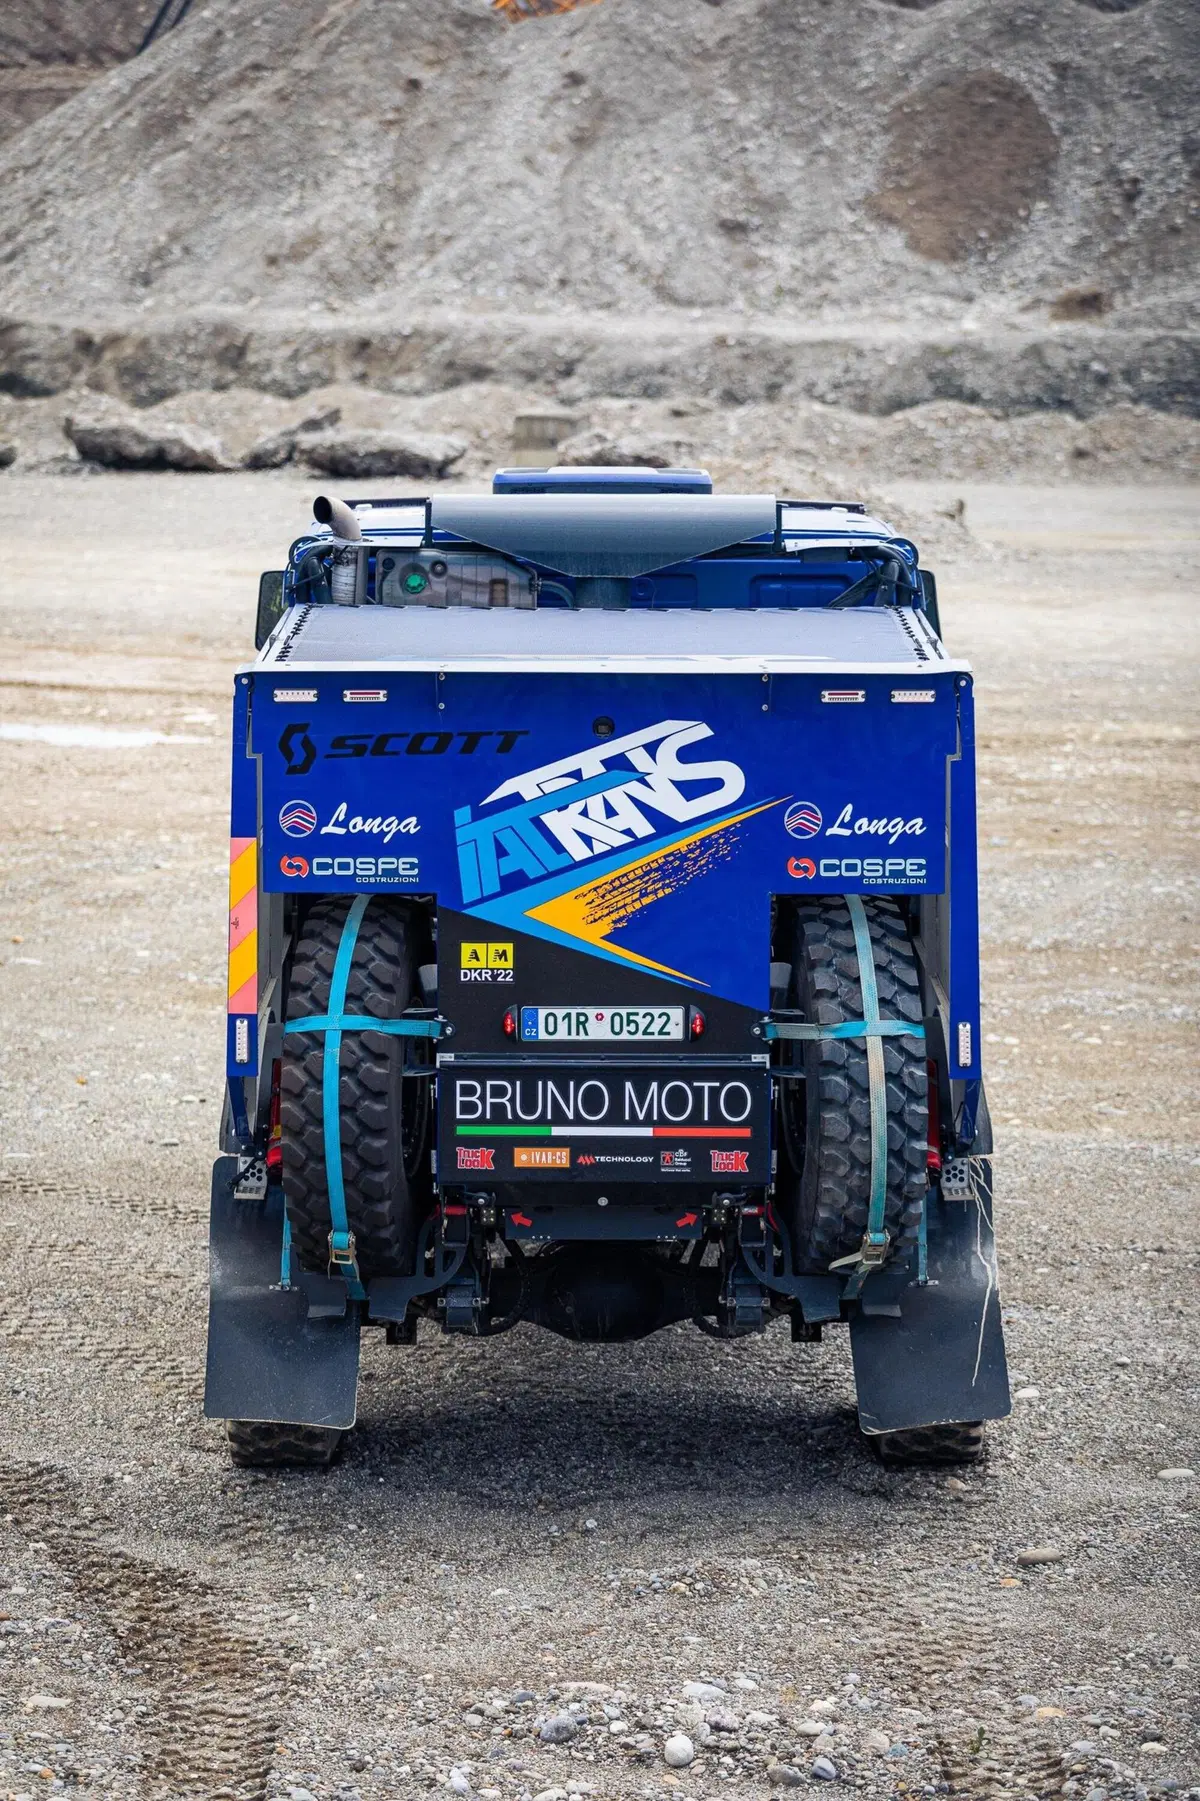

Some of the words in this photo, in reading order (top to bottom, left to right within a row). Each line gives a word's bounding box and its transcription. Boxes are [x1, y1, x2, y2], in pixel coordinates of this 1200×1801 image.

[323, 730, 529, 759] SCOTT
[320, 802, 421, 843] Longa
[825, 803, 928, 845] Longa
[312, 857, 419, 876] COSPE
[820, 858, 927, 877] COSPE
[544, 1012, 589, 1037] 01R
[610, 1012, 671, 1037] 0522
[456, 1080, 609, 1121] BRUNO
[624, 1081, 752, 1122] MOTO
